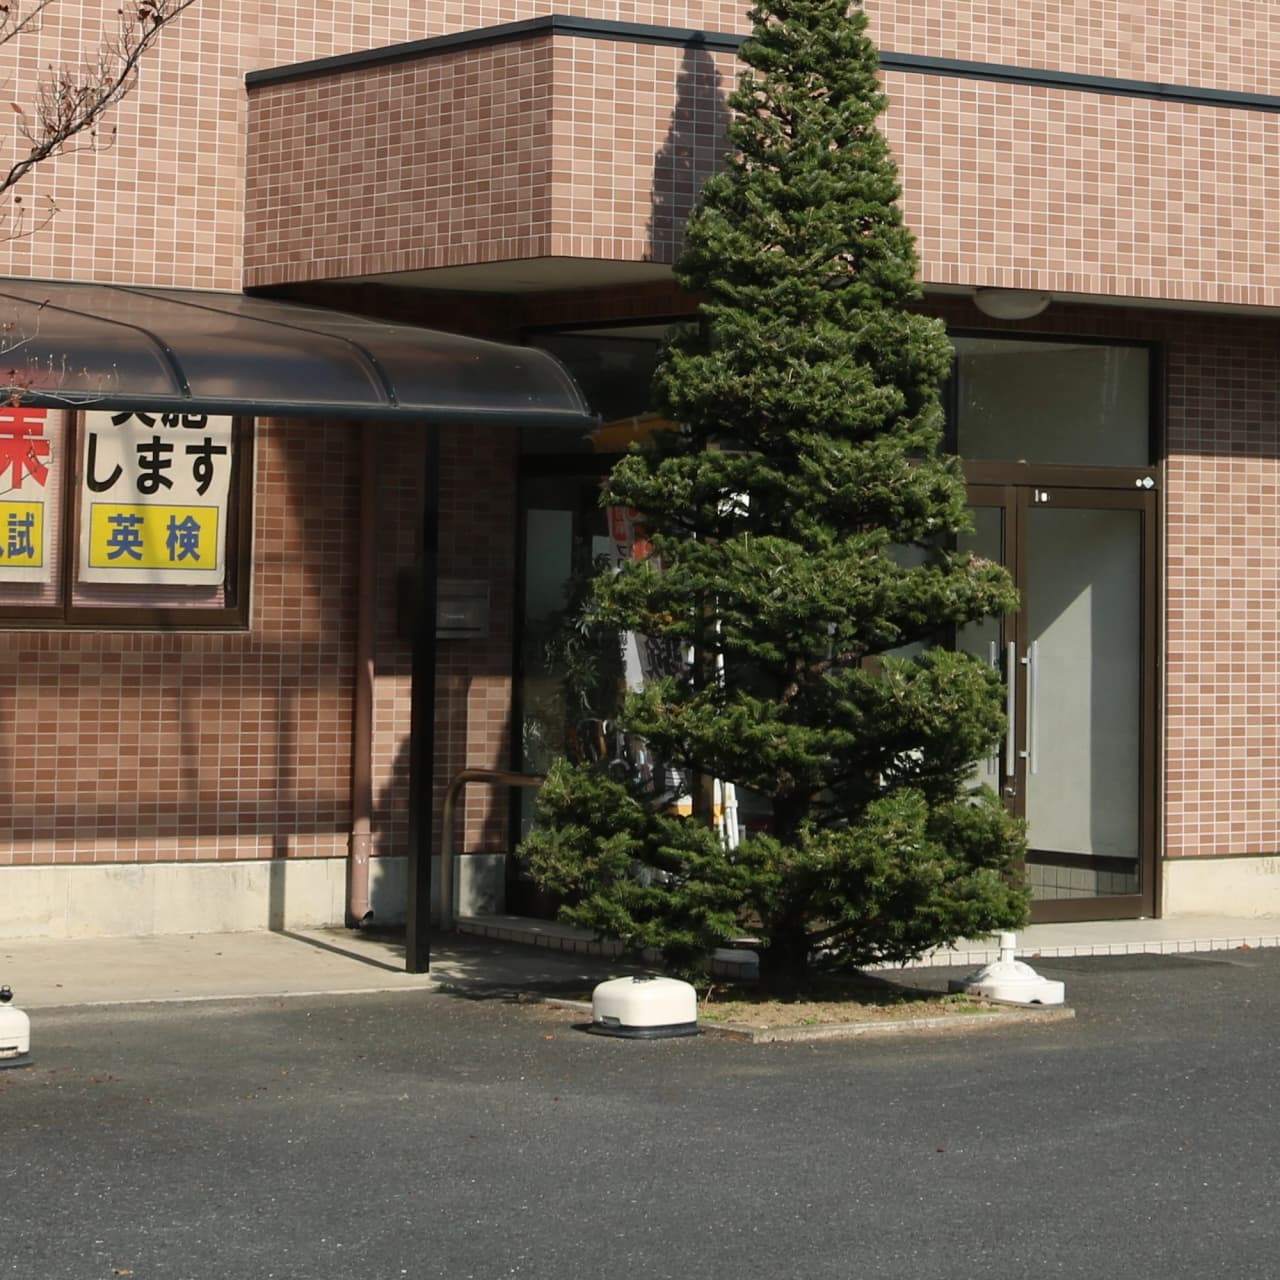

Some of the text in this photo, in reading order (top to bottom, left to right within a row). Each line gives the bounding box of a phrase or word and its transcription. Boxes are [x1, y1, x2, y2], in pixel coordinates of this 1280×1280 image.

[86, 431, 227, 497] します
[106, 513, 201, 562] 英検
